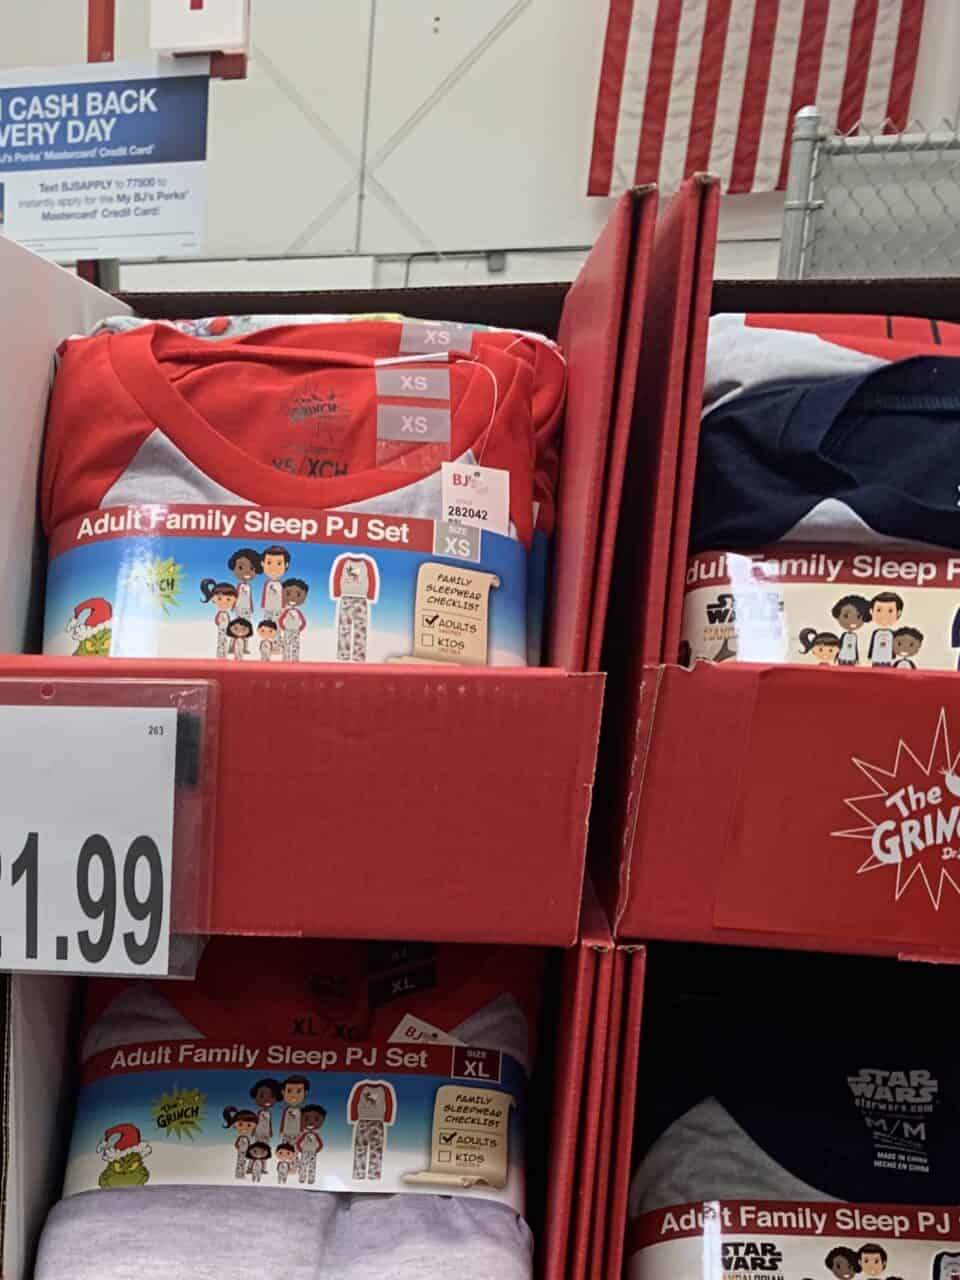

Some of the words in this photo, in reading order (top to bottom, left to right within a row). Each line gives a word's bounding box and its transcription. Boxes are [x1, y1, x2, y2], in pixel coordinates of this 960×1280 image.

[9, 95, 81, 120] CASH
[86, 88, 157, 114] BACK
[66, 119, 116, 143] DAY
[99, 148, 127, 157] Credit
[41, 183, 59, 193] Text
[101, 207, 131, 218] Credit
[424, 331, 449, 344] XS
[401, 376, 427, 390] XS
[401, 416, 428, 432] XS
[448, 506, 488, 520] 282042
[77, 509, 142, 539] Adult
[149, 507, 235, 539] Family
[244, 511, 317, 541] Sleep
[326, 519, 358, 541] PJ
[366, 522, 409, 543] Set
[445, 537, 471, 557] XS
[852, 555, 936, 584] Sleep
[438, 573, 472, 585] FAMILY
[426, 584, 481, 600] SLEEPWEAR
[427, 595, 479, 611] CHECKLIST
[438, 618, 477, 633] ADULTS
[148, 725, 164, 736] 263
[885, 784, 943, 818] The
[111, 1047, 170, 1070] Adult
[178, 1044, 260, 1069] Family
[267, 1045, 338, 1070] Sleep
[346, 1047, 377, 1066] PJ
[387, 1047, 429, 1069] Set
[464, 1060, 490, 1077] XL
[847, 1068, 938, 1087] STAR
[455, 1094, 493, 1104] FAMILY
[848, 1083, 938, 1103] WARS
[156, 1103, 200, 1129] GRINCH
[456, 1136, 497, 1148] ADULTS
[455, 1153, 485, 1163] KIDS
[740, 1207, 827, 1234] Family
[835, 1210, 910, 1237] Sleep
[918, 1211, 950, 1233] PJ
